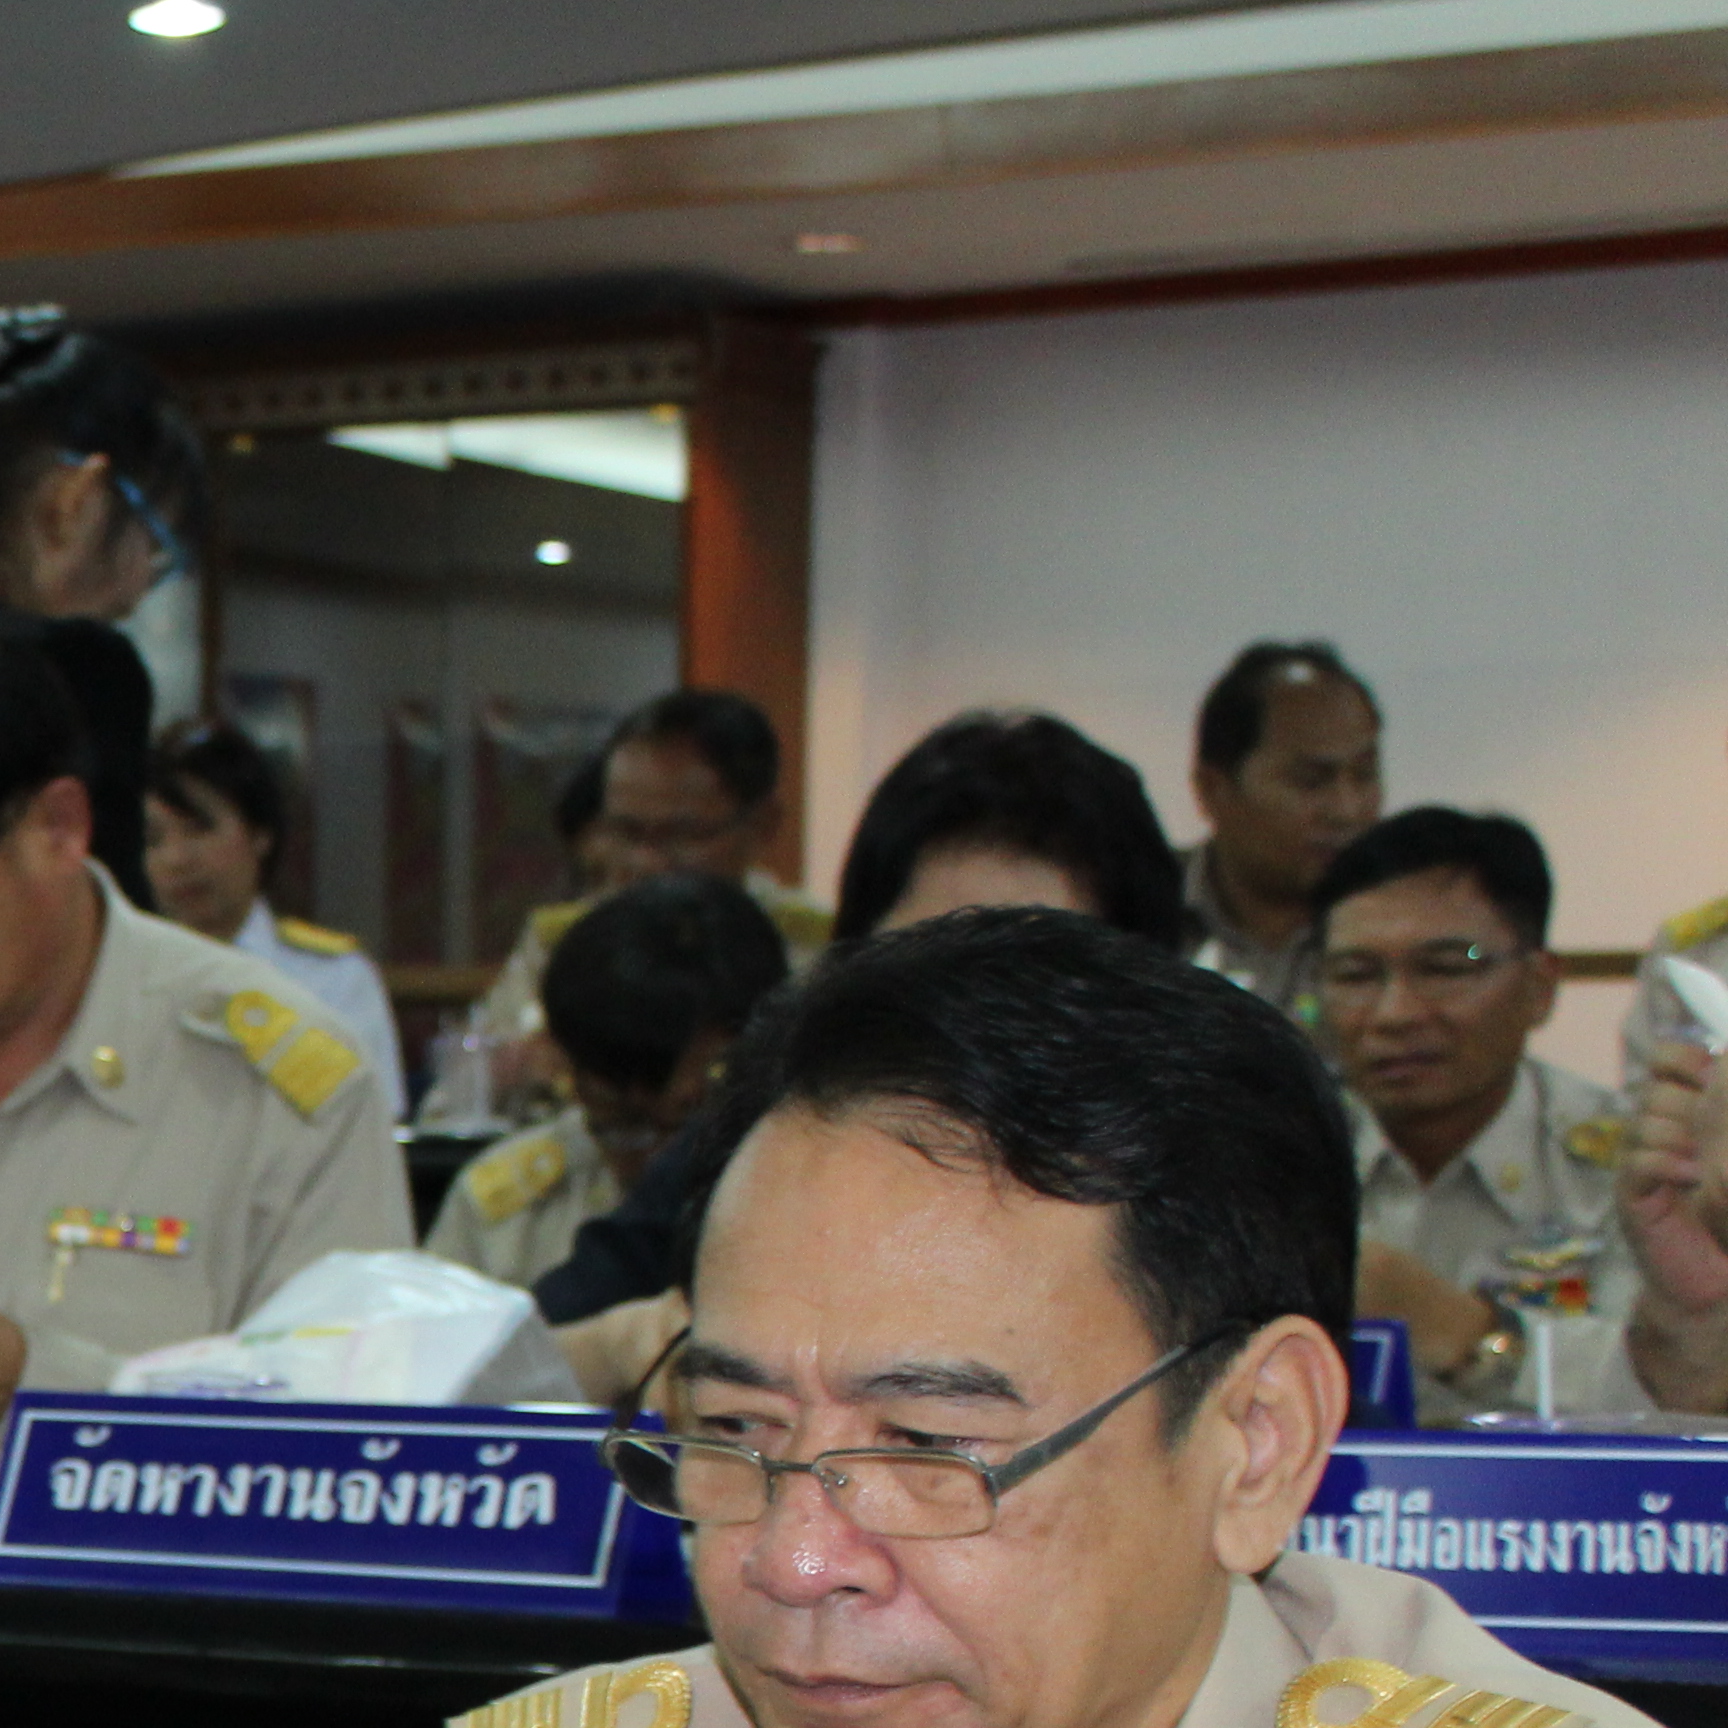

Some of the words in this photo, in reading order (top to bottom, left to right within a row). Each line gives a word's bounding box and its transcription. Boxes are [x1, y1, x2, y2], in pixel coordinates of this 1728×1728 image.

[50, 1426, 556, 1530] จัดหางานจังหวัด
[1286, 1487, 1728, 1576] นาฝีมือแรงงานจังห
